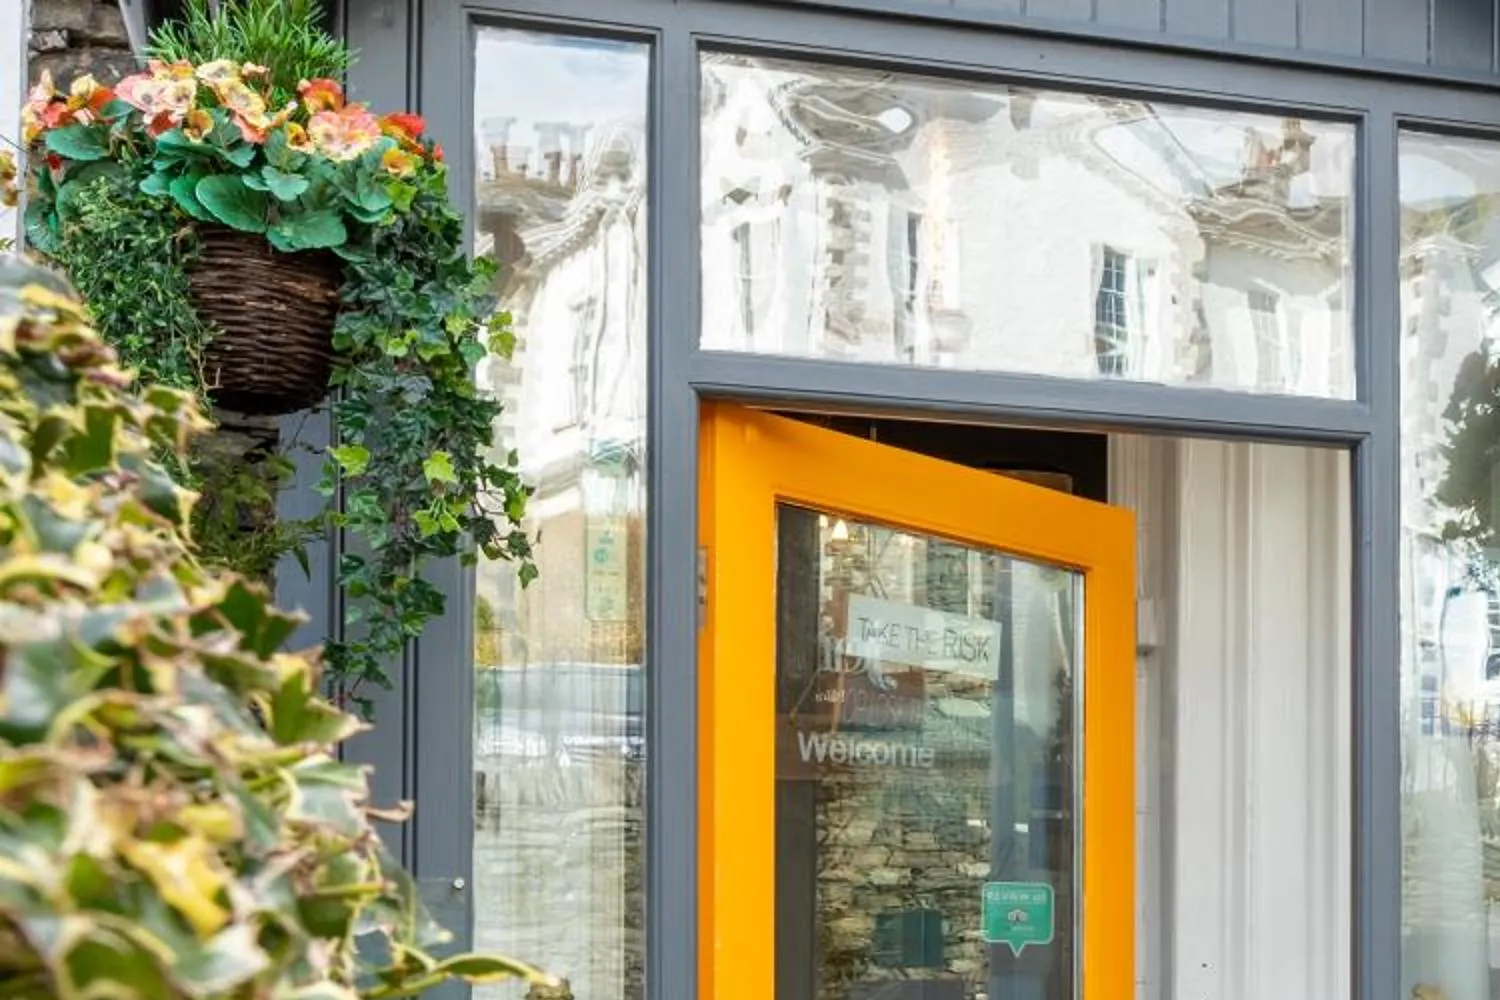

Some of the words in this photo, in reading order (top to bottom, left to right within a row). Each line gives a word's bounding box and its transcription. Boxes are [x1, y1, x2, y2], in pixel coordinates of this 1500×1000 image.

[857, 617, 900, 648] TAKE
[904, 624, 938, 656] THE
[943, 627, 991, 662] RISK
[797, 730, 935, 768] Welcome
